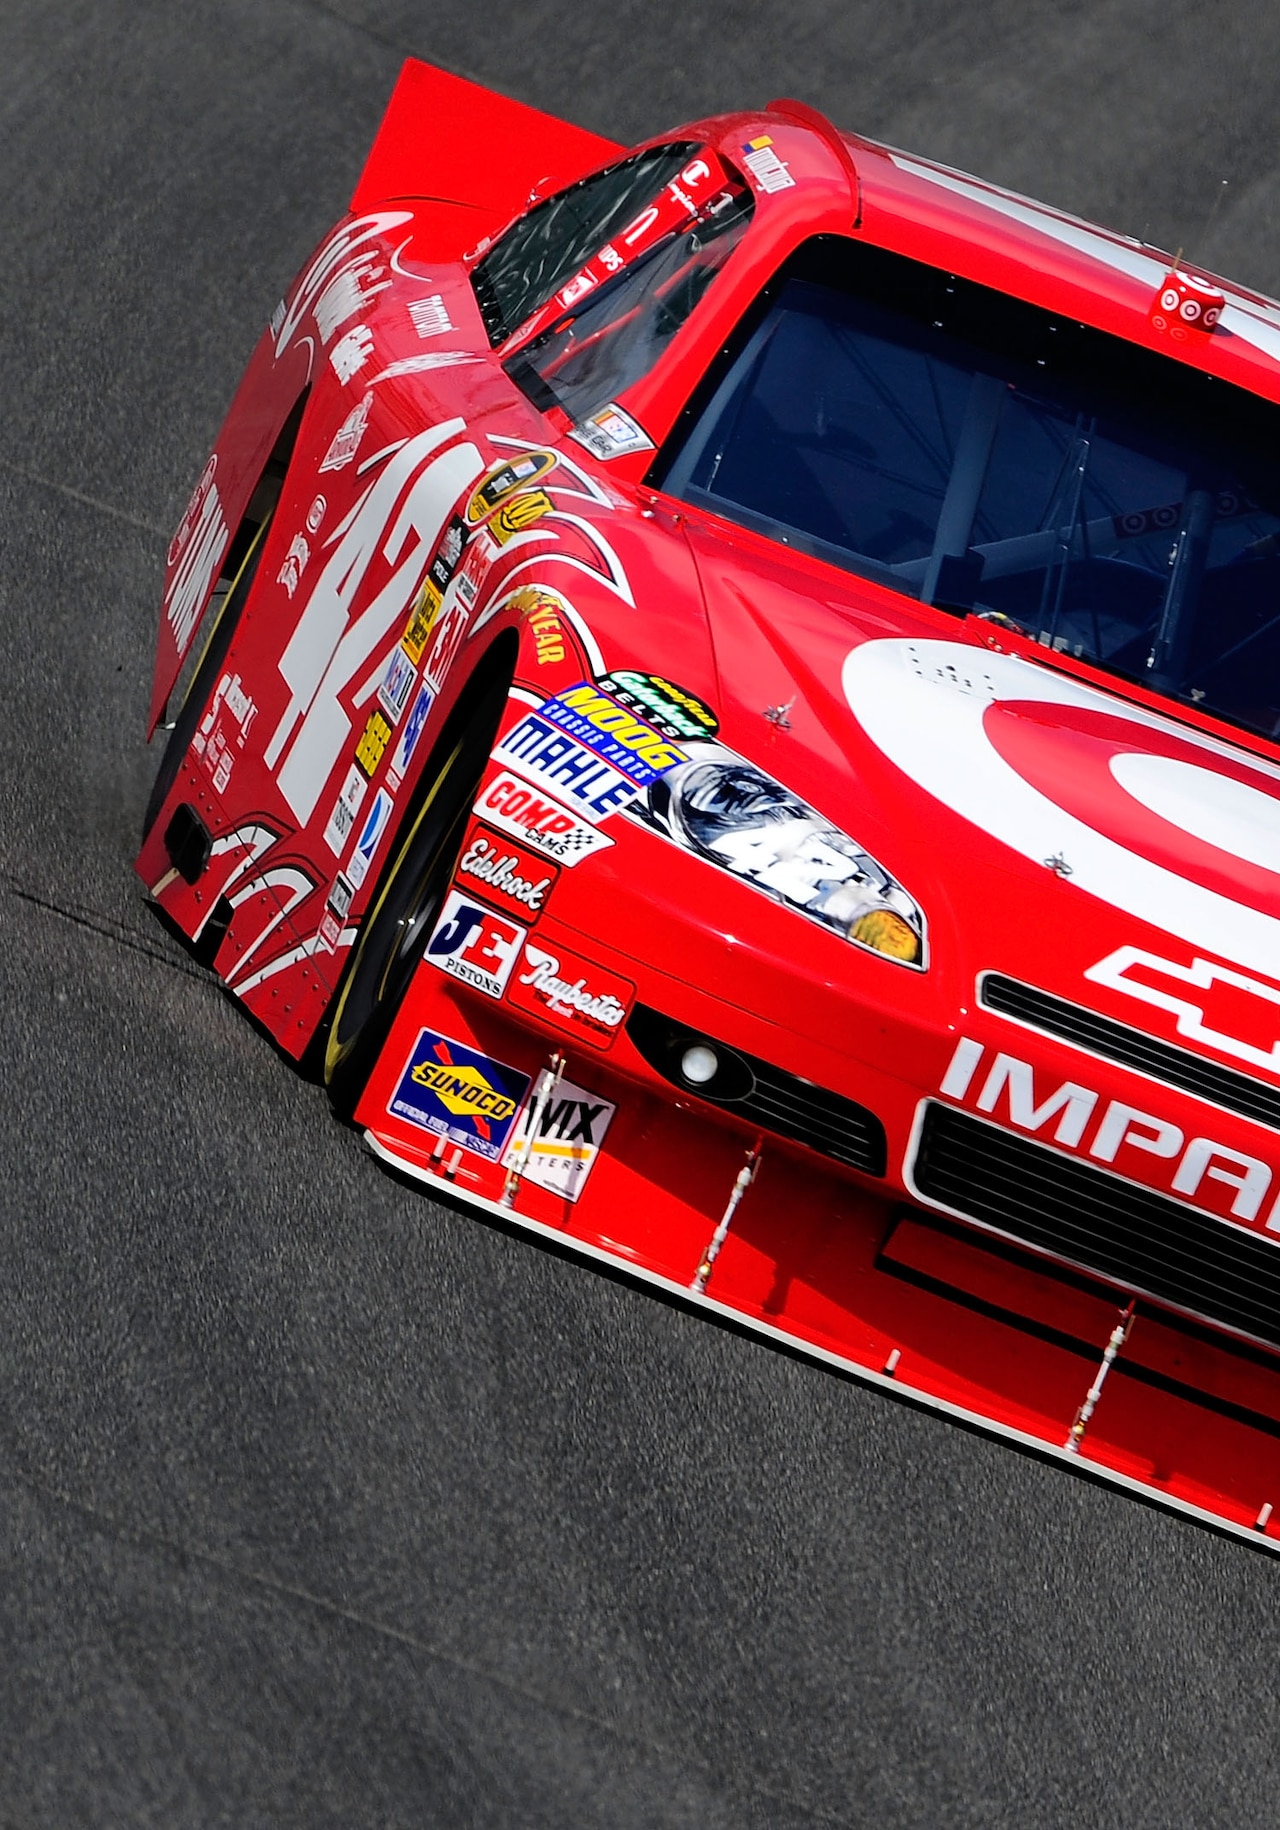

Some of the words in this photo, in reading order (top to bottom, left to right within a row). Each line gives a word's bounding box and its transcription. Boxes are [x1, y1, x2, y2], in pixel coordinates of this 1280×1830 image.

[263, 416, 484, 830] 42
[543, 703, 605, 745] CHASSIS
[602, 743, 652, 780] PARTS
[555, 686, 690, 771] MOOG
[598, 680, 681, 738] BELTS
[486, 780, 576, 834] COMP
[461, 838, 551, 910] Edelbrock
[428, 904, 519, 976] JE
[445, 957, 502, 996] PISTONS
[518, 943, 626, 1026] Raybestos
[416, 1064, 514, 1118] SUNOCO
[525, 1095, 609, 1144] WIX
[505, 1153, 585, 1172] FTERS
